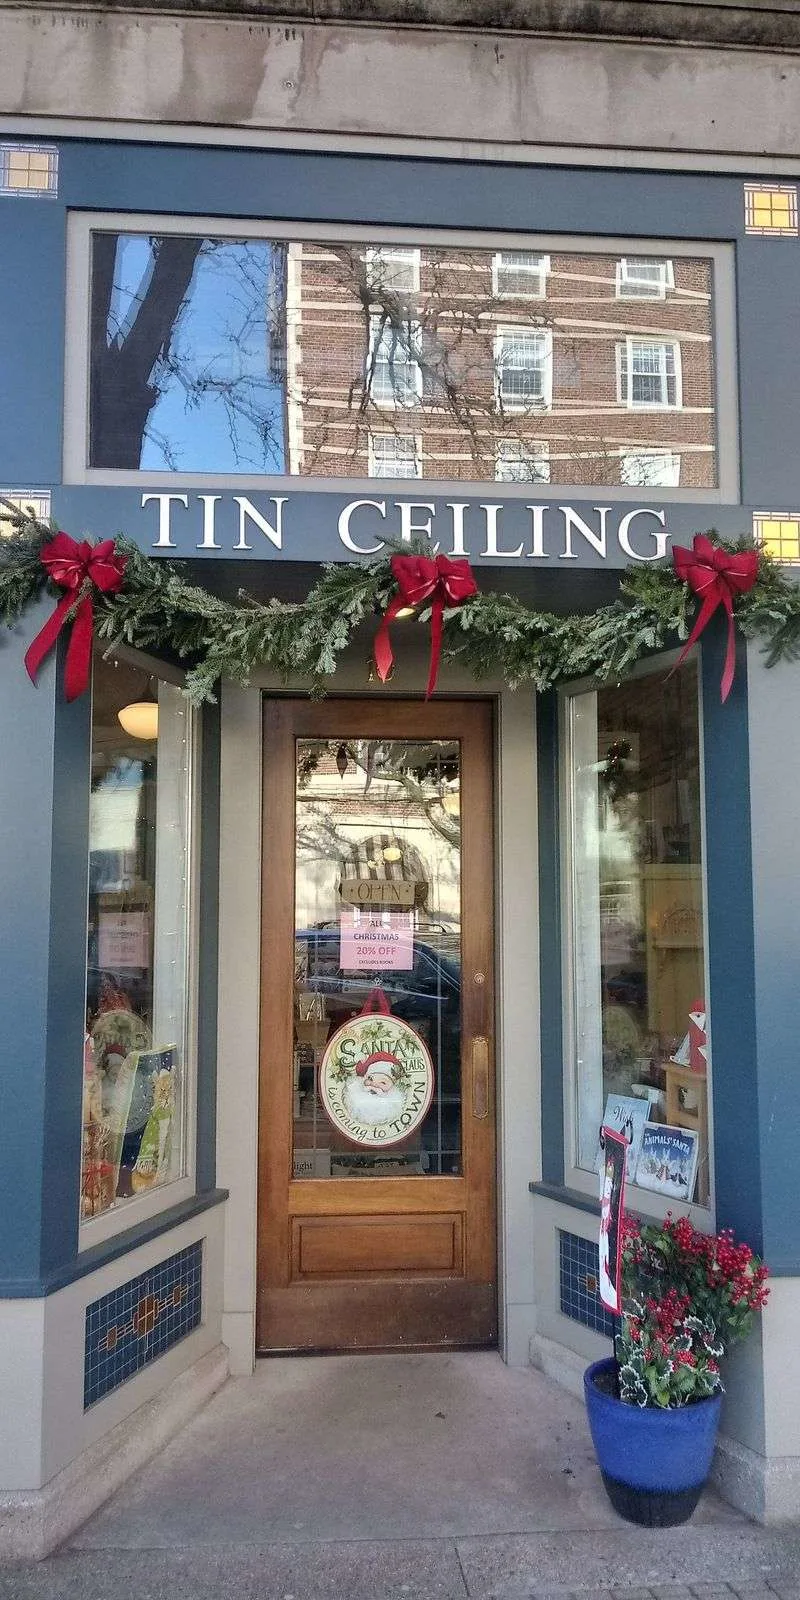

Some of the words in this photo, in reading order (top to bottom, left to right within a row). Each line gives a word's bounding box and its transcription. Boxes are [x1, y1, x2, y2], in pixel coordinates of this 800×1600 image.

[141, 493, 289, 550] TIN
[337, 499, 672, 561] CEILING
[357, 881, 401, 901] OPEN
[353, 933, 400, 941] CHRISTMAS
[357, 946, 376, 956] 20%
[378, 946, 397, 956] OFF
[339, 1038, 408, 1068] SANTA
[327, 1087, 338, 1101] is
[389, 1081, 426, 1133] TOWN
[331, 1100, 369, 1141] coming
[373, 1127, 387, 1139] to
[672, 1138, 691, 1155] SANTA
